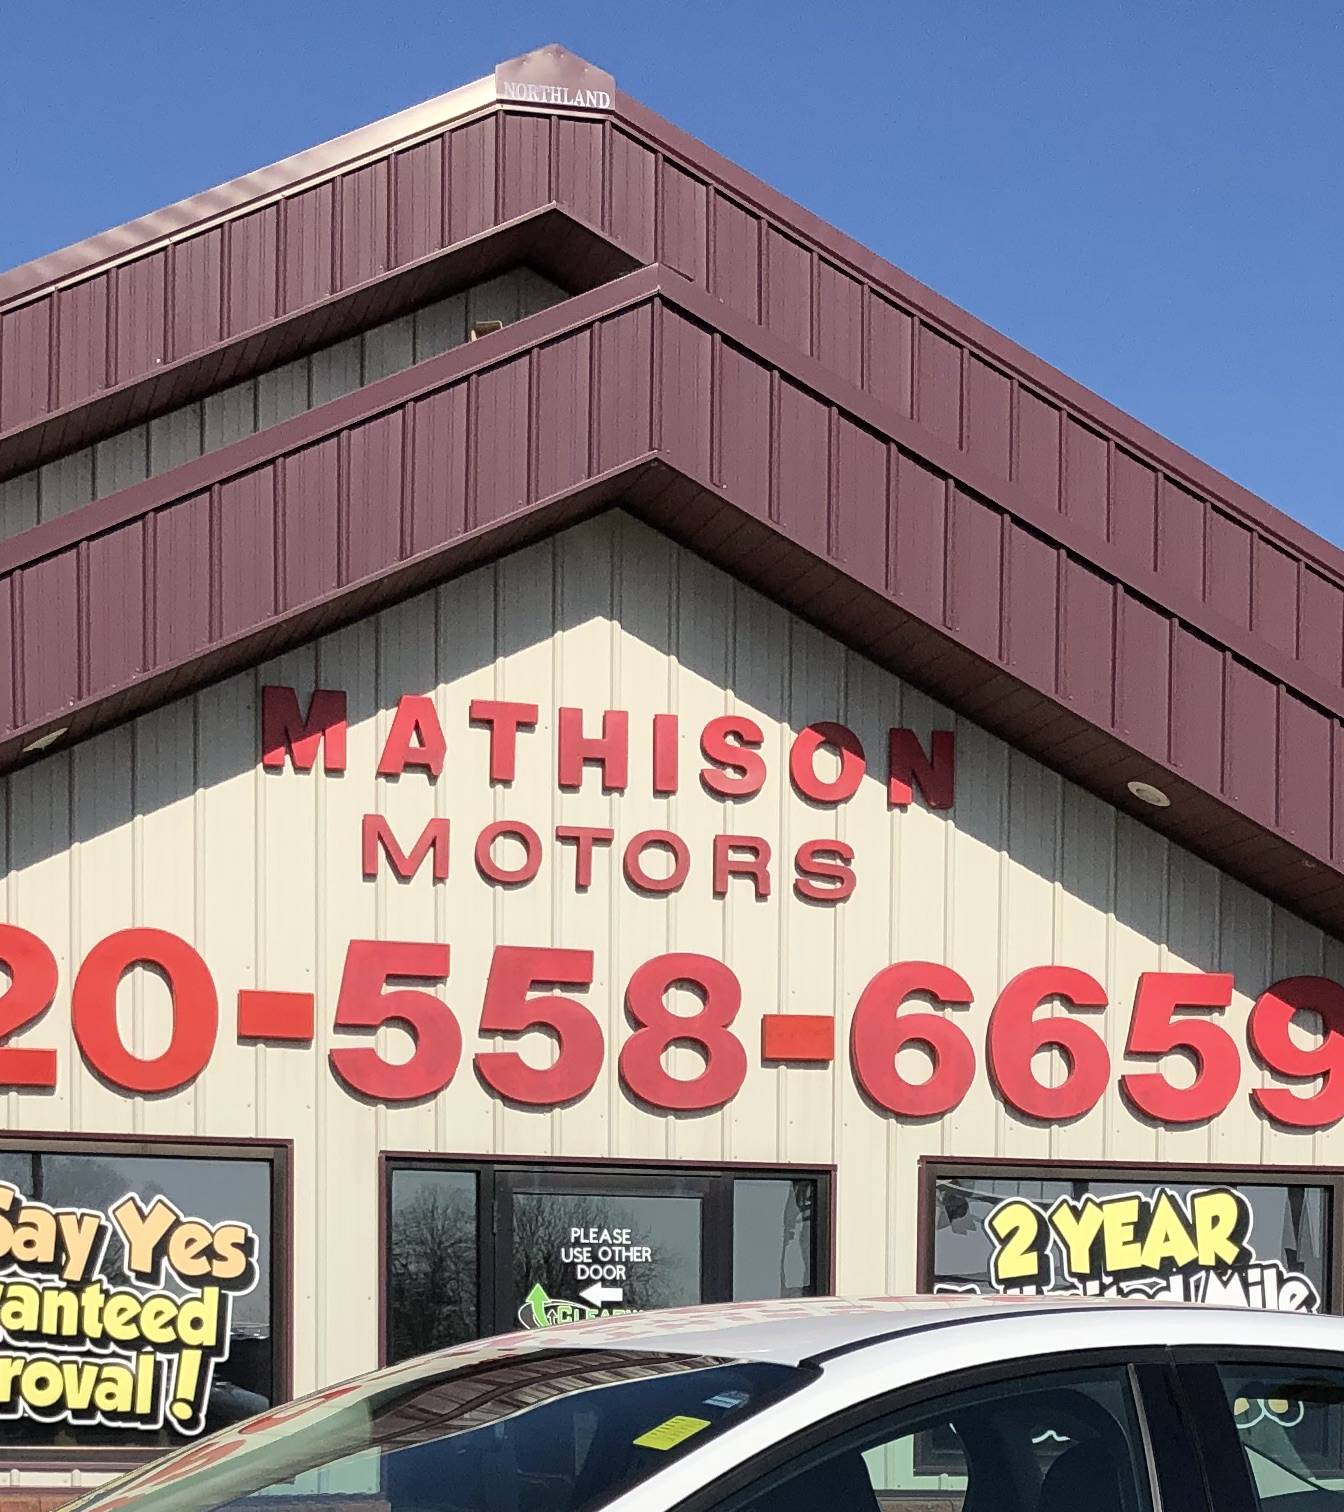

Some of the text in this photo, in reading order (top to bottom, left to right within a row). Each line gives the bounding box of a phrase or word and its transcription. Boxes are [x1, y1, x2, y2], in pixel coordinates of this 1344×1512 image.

[505, 82, 610, 108] NORTHLAND
[261, 684, 956, 809] MATHISON
[361, 812, 857, 902] MOTORS
[113, 1197, 250, 1280] Yes
[560, 1245, 653, 1263] USE OTHER
[570, 1227, 632, 1245] PLEASE
[990, 1188, 1241, 1280] 2 YEAR
[576, 1263, 627, 1281] DOOR
